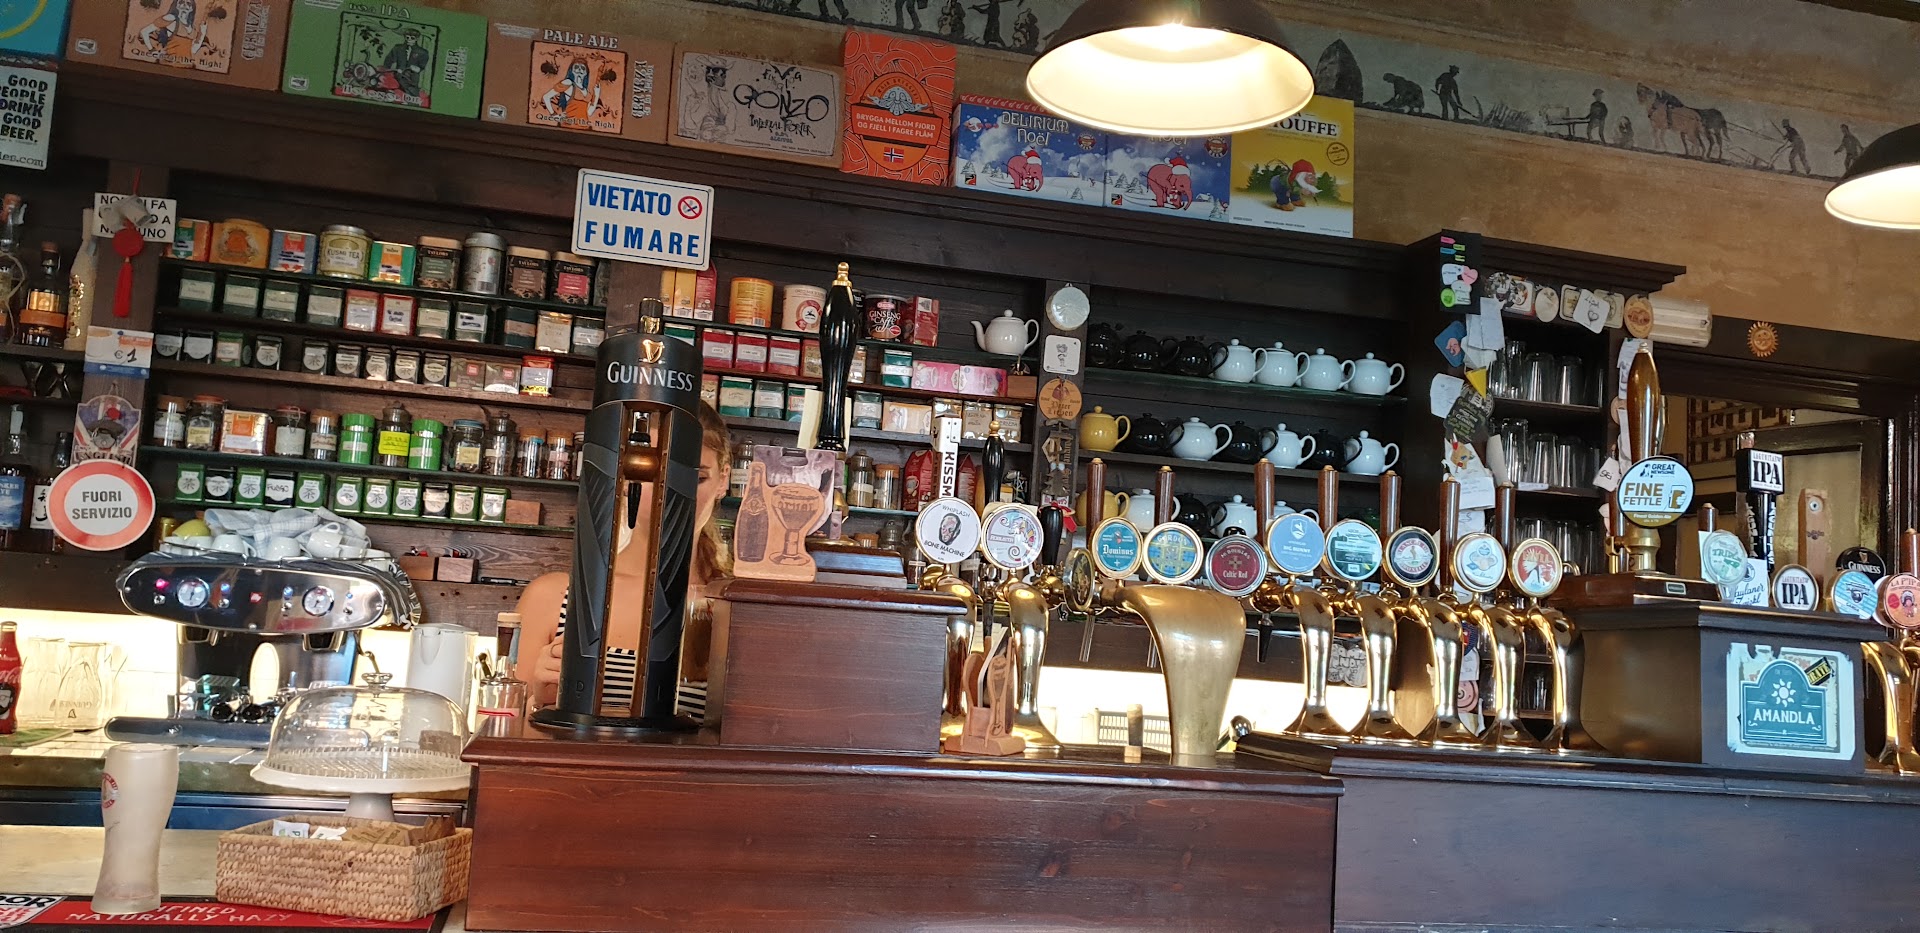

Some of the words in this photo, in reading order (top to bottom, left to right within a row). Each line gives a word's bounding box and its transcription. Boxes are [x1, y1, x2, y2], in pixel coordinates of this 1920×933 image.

[543, 29, 584, 46] PALE
[587, 37, 619, 50] ALE
[199, 58, 222, 69] Night
[443, 48, 460, 83] BEER
[8, 74, 48, 93] GOOD
[631, 61, 648, 119] CERVEZA
[0, 85, 46, 106] EOPLE
[733, 83, 829, 122] GONZO
[3, 112, 42, 130] GOOD
[594, 119, 616, 129] Night
[856, 112, 884, 123] BRYGGA
[885, 117, 914, 128] MELLOM
[915, 122, 936, 131] FJORD
[857, 121, 868, 129] OG
[869, 124, 887, 132] FJELL
[892, 127, 914, 135] FAGRE
[915, 128, 934, 138] FLÅM
[1001, 111, 1070, 134] DELIRIUM
[1268, 117, 1338, 137] HOUFFE
[0, 124, 38, 143] BEER.
[1016, 128, 1051, 147] Noël
[151, 199, 167, 210] FA
[587, 182, 672, 216] VIETATO
[162, 215, 171, 225] A
[585, 220, 700, 258] FUMARE
[348, 251, 360, 259] TEA
[869, 310, 901, 320] GINSENG
[607, 361, 691, 392] GUINNESS
[1752, 460, 1782, 486] IPA
[82, 490, 122, 503] FUORI
[1624, 482, 1664, 497] FINE
[1623, 497, 1662, 506] FETTLE
[72, 506, 133, 520] SERVIZIO
[942, 504, 971, 518] WHIPLASH
[1767, 501, 1776, 565] LAGUNITAS
[923, 540, 941, 551] BONE
[940, 545, 965, 558] MACHINE
[1102, 544, 1134, 556] Dominus
[1222, 570, 1237, 578] Celtic
[1238, 571, 1248, 579] Red
[1848, 560, 1881, 574] GUINNESS
[1781, 582, 1810, 605] IPA
[1753, 708, 1815, 725] AMANDLA
[65, 913, 220, 922] NATURALLY
[229, 913, 293, 923] HAZY
